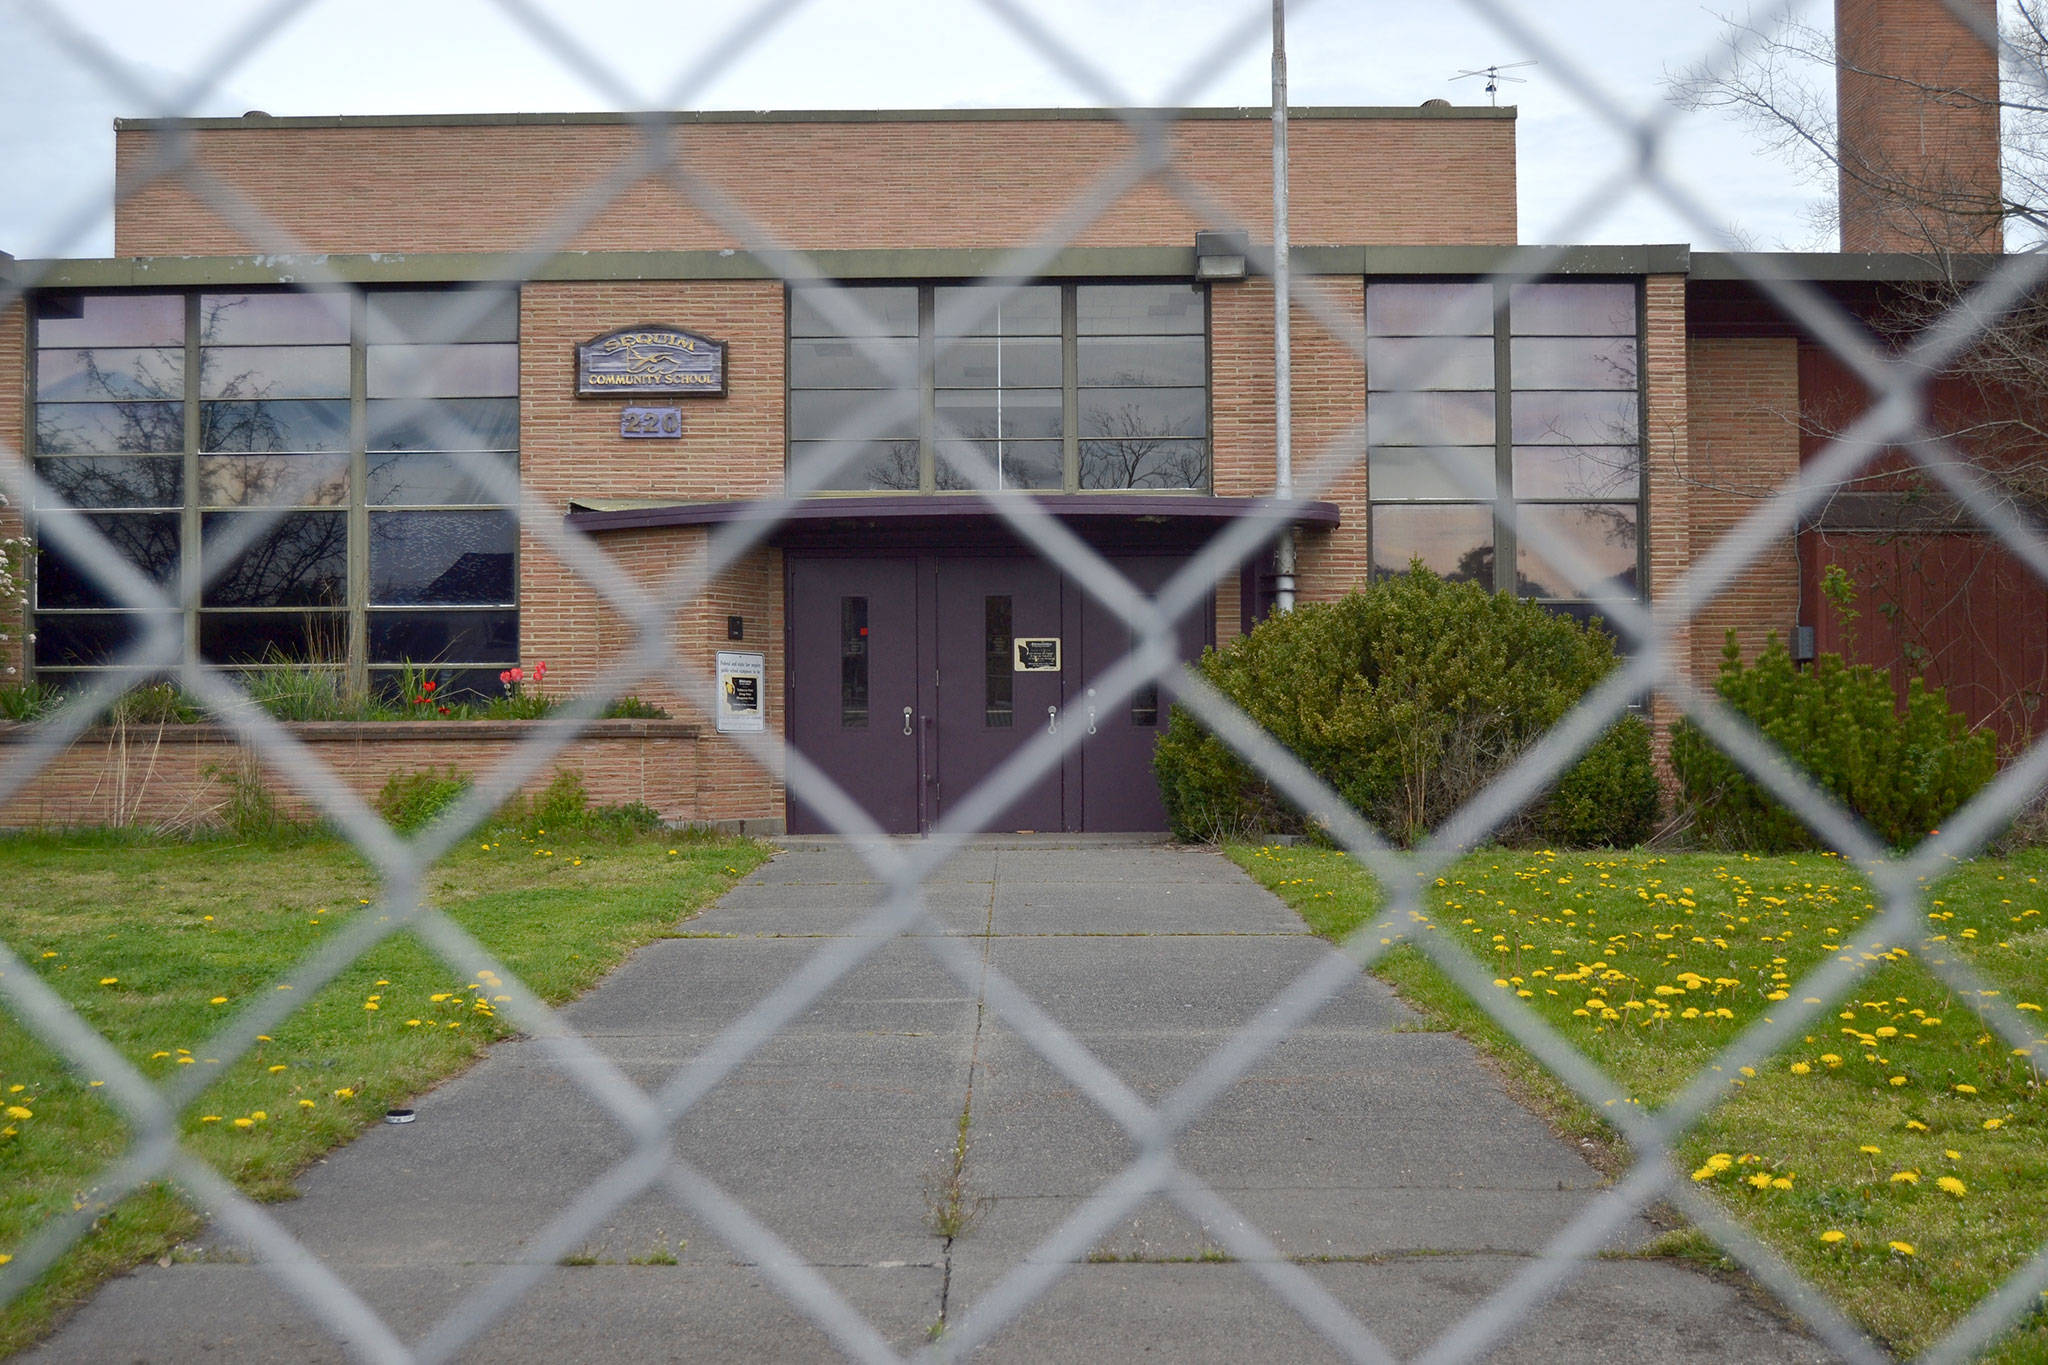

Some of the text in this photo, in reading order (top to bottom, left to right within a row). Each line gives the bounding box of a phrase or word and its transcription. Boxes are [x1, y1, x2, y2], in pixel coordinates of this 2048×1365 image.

[604, 333, 696, 351] SEQUIM
[588, 374, 713, 385] COMMUNITY SCHOOL
[623, 412, 680, 433] 220
